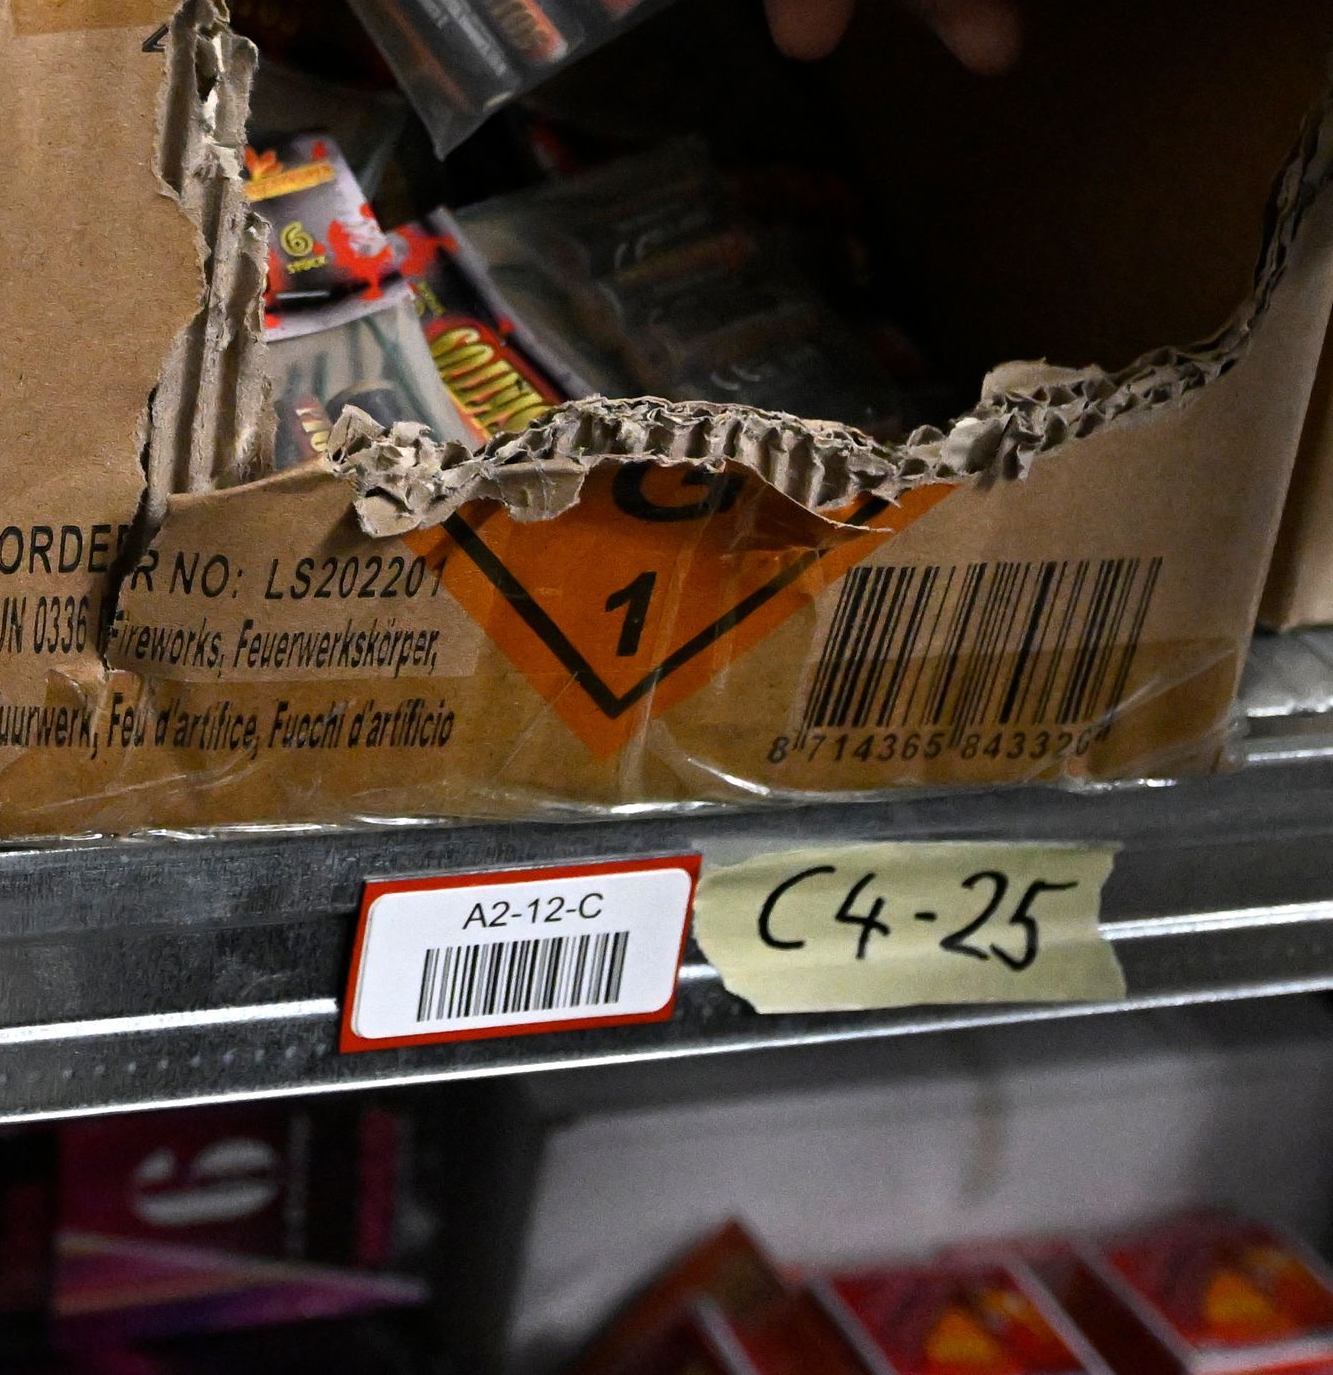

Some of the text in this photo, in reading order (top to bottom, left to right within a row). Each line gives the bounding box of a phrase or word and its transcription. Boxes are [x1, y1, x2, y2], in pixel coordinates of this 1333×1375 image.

[170, 551, 244, 600] NO:
[264, 555, 448, 601] LS202201
[604, 571, 658, 658] 1
[33, 593, 91, 655] 0336
[233, 618, 441, 679] Feuerwerkskörper,
[107, 692, 148, 748] Feu
[153, 697, 262, 761] d'artifice,
[347, 697, 456, 748] d'artificio
[462, 891, 605, 930] A2-12-C
[758, 863, 1078, 972] C4-25
